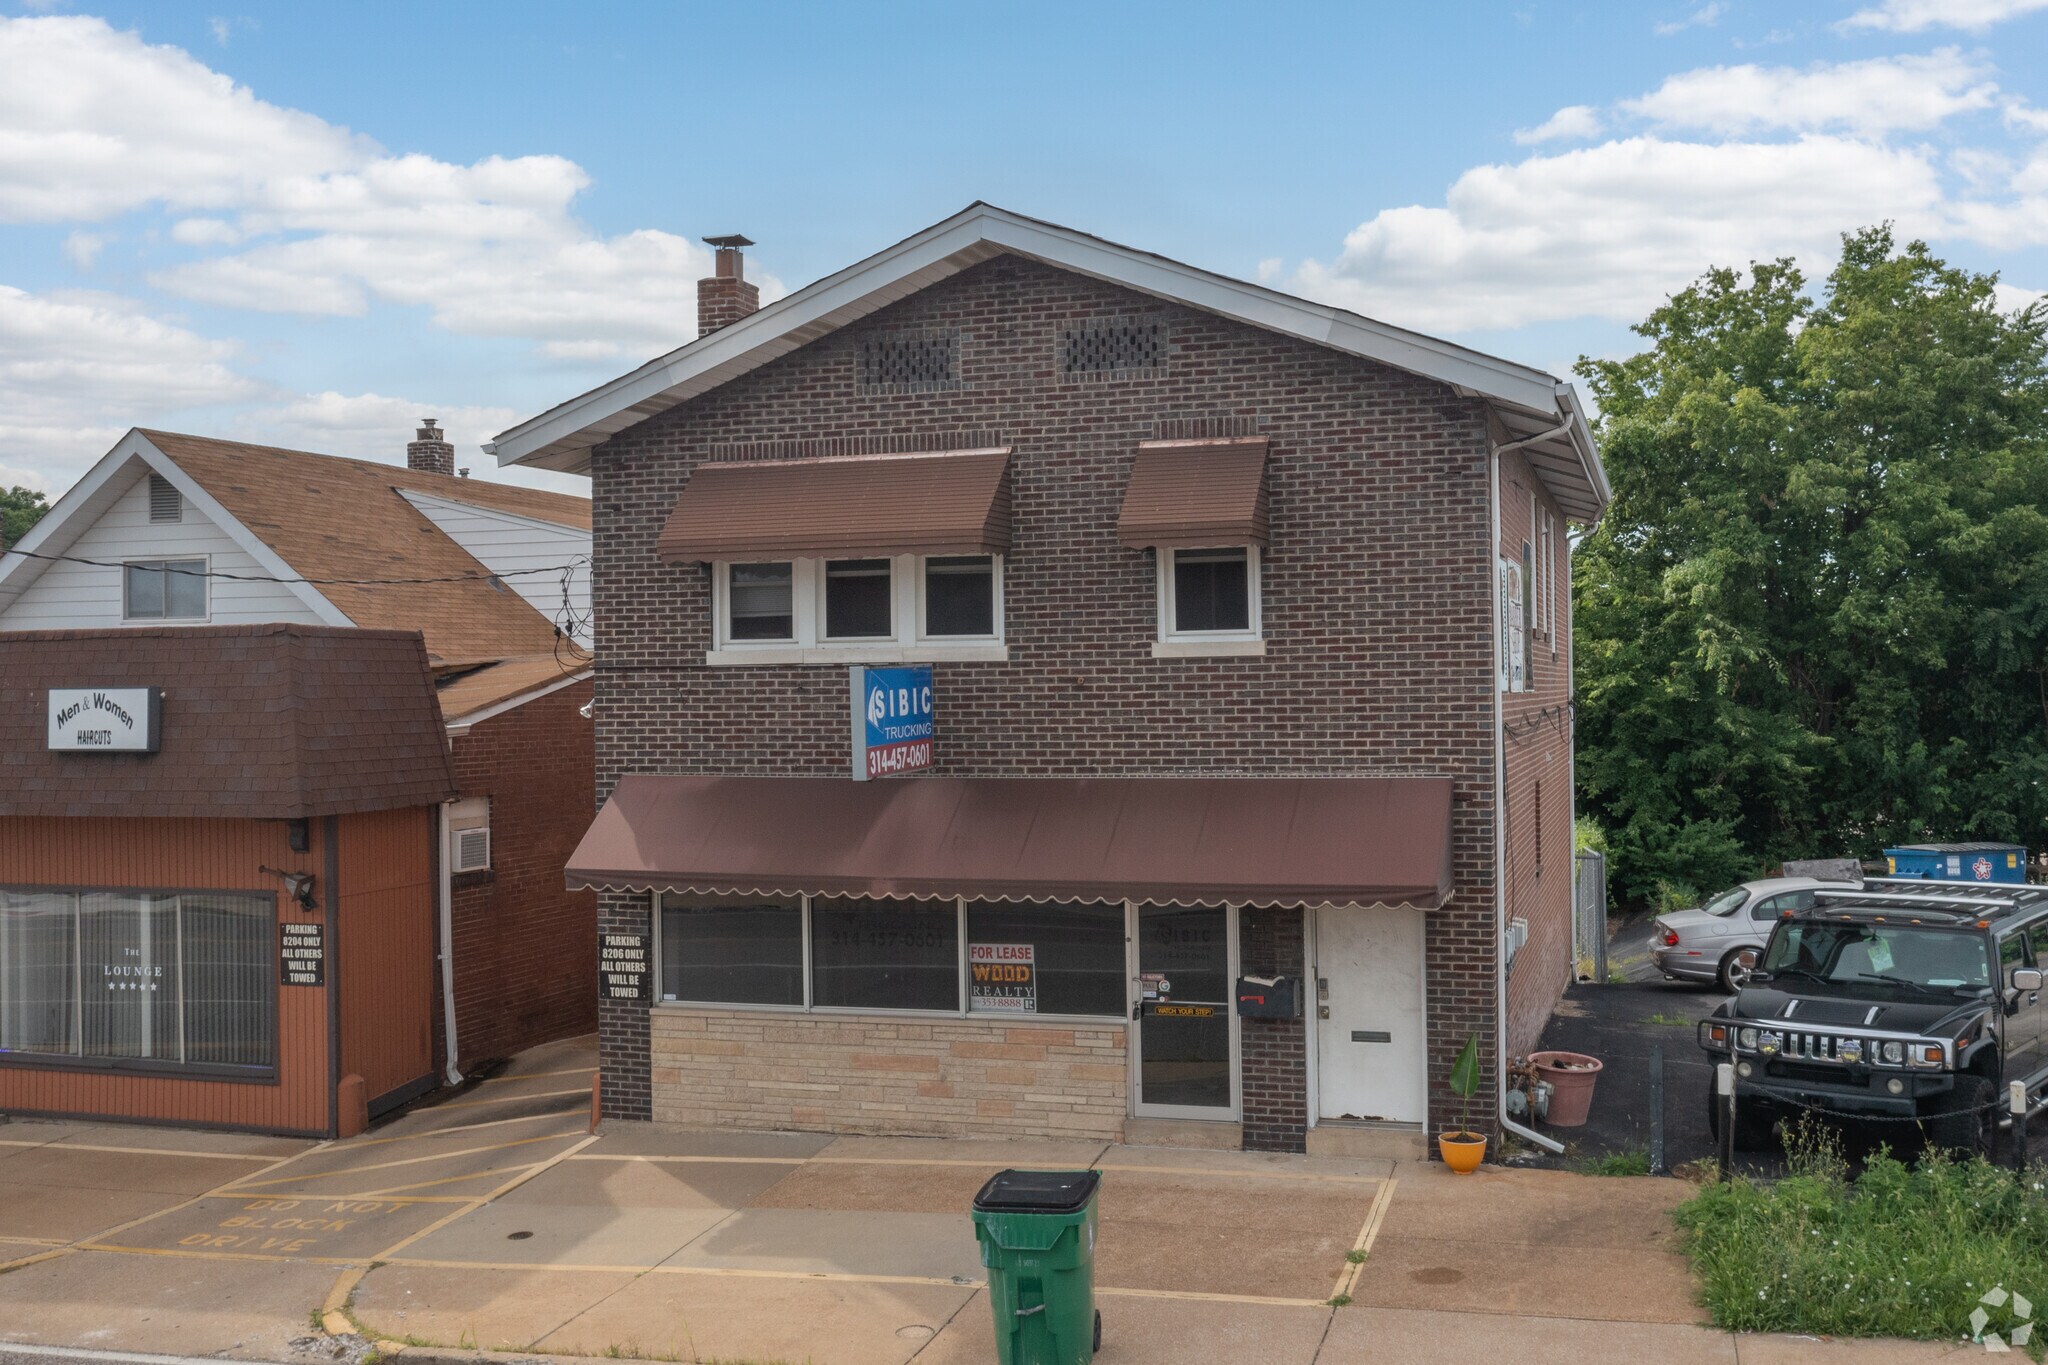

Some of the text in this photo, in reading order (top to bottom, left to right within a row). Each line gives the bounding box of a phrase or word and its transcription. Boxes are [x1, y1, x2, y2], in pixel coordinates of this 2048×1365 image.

[875, 686, 931, 719] SIBIC
[57, 692, 134, 730] Men & Women
[885, 722, 932, 740] TRUCKING
[77, 730, 112, 745] HAIRCUTS
[869, 743, 930, 774] 314-457-0601
[285, 924, 318, 935] PARKING
[282, 936, 321, 947] 8204 ONLY
[605, 935, 641, 947] PARKING
[281, 948, 323, 959] ALL OTHERS
[602, 948, 645, 960] 8206 ONLY
[971, 946, 1032, 960] FOR LEASE
[104, 965, 162, 977] LOUNGE
[288, 960, 317, 971] WILL BE
[601, 961, 646, 973] ALL OTHERS
[289, 972, 316, 983] TOWED
[972, 964, 1031, 982] WOOD
[608, 974, 640, 985] WILL BE
[609, 986, 639, 998] TOWED
[973, 985, 1033, 997] REALTY
[243, 1200, 413, 1214] DO NOT
[218, 1216, 357, 1232] BLOCK
[177, 1233, 318, 1251] DRIVE
